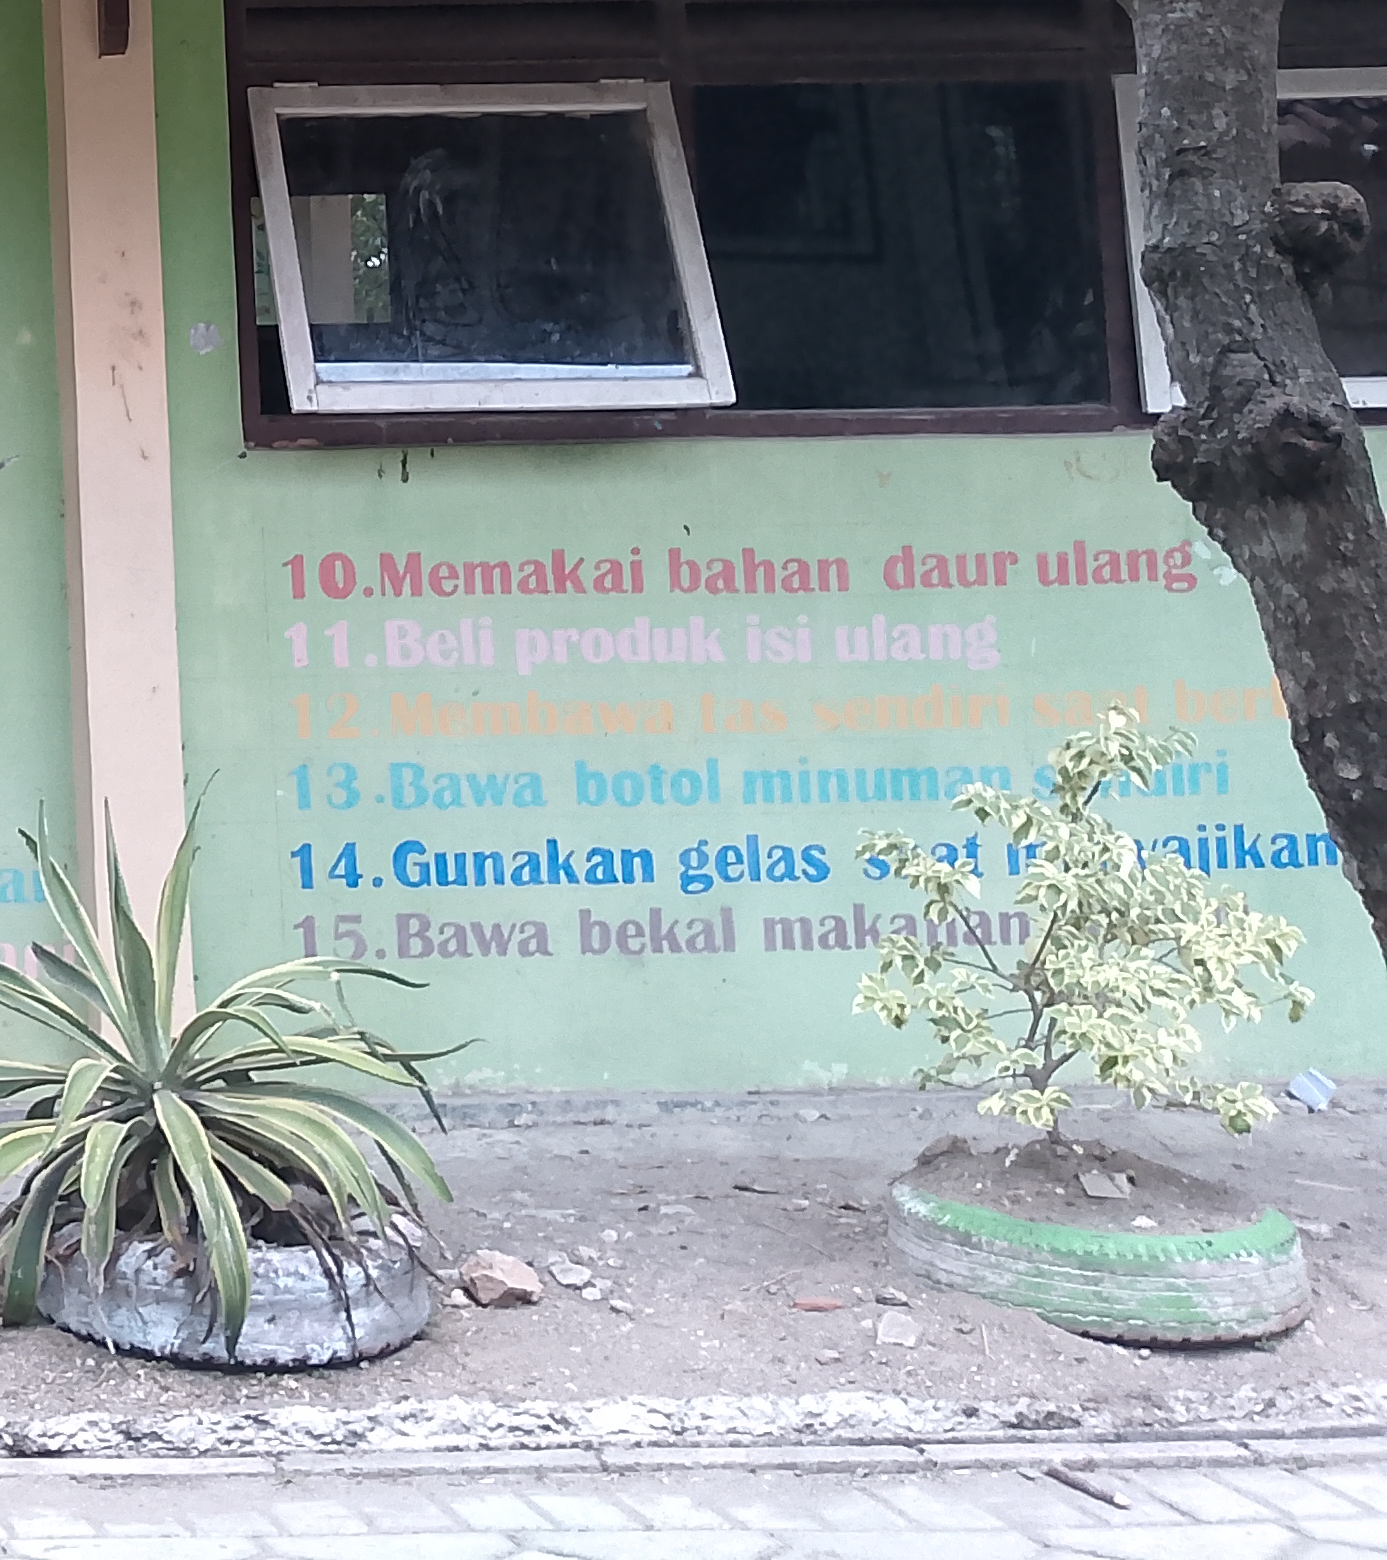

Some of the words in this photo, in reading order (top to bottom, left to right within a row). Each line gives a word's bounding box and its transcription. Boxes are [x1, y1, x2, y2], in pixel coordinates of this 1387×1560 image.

[282, 547, 646, 601] 10.Memakai
[667, 547, 850, 595] bahan
[883, 545, 1019, 591] daur
[1037, 540, 1198, 593] ulang
[284, 615, 495, 669] 11.Beli
[516, 615, 727, 676] produk
[746, 614, 812, 664] isi
[835, 613, 1001, 670] ulang
[289, 689, 675, 739] 12.Membawa
[699, 691, 789, 734] tas
[811, 682, 1011, 732] sendiri
[288, 760, 548, 812] 13.Bawa
[574, 757, 720, 808] botol
[742, 756, 1012, 805] minuman
[290, 837, 656, 890] 14.Gunakan
[678, 834, 831, 896] gelas
[862, 831, 984, 881] sat
[292, 912, 555, 962] 15.Bawa
[578, 907, 737, 957] bekal
[762, 902, 1033, 955] makanan
